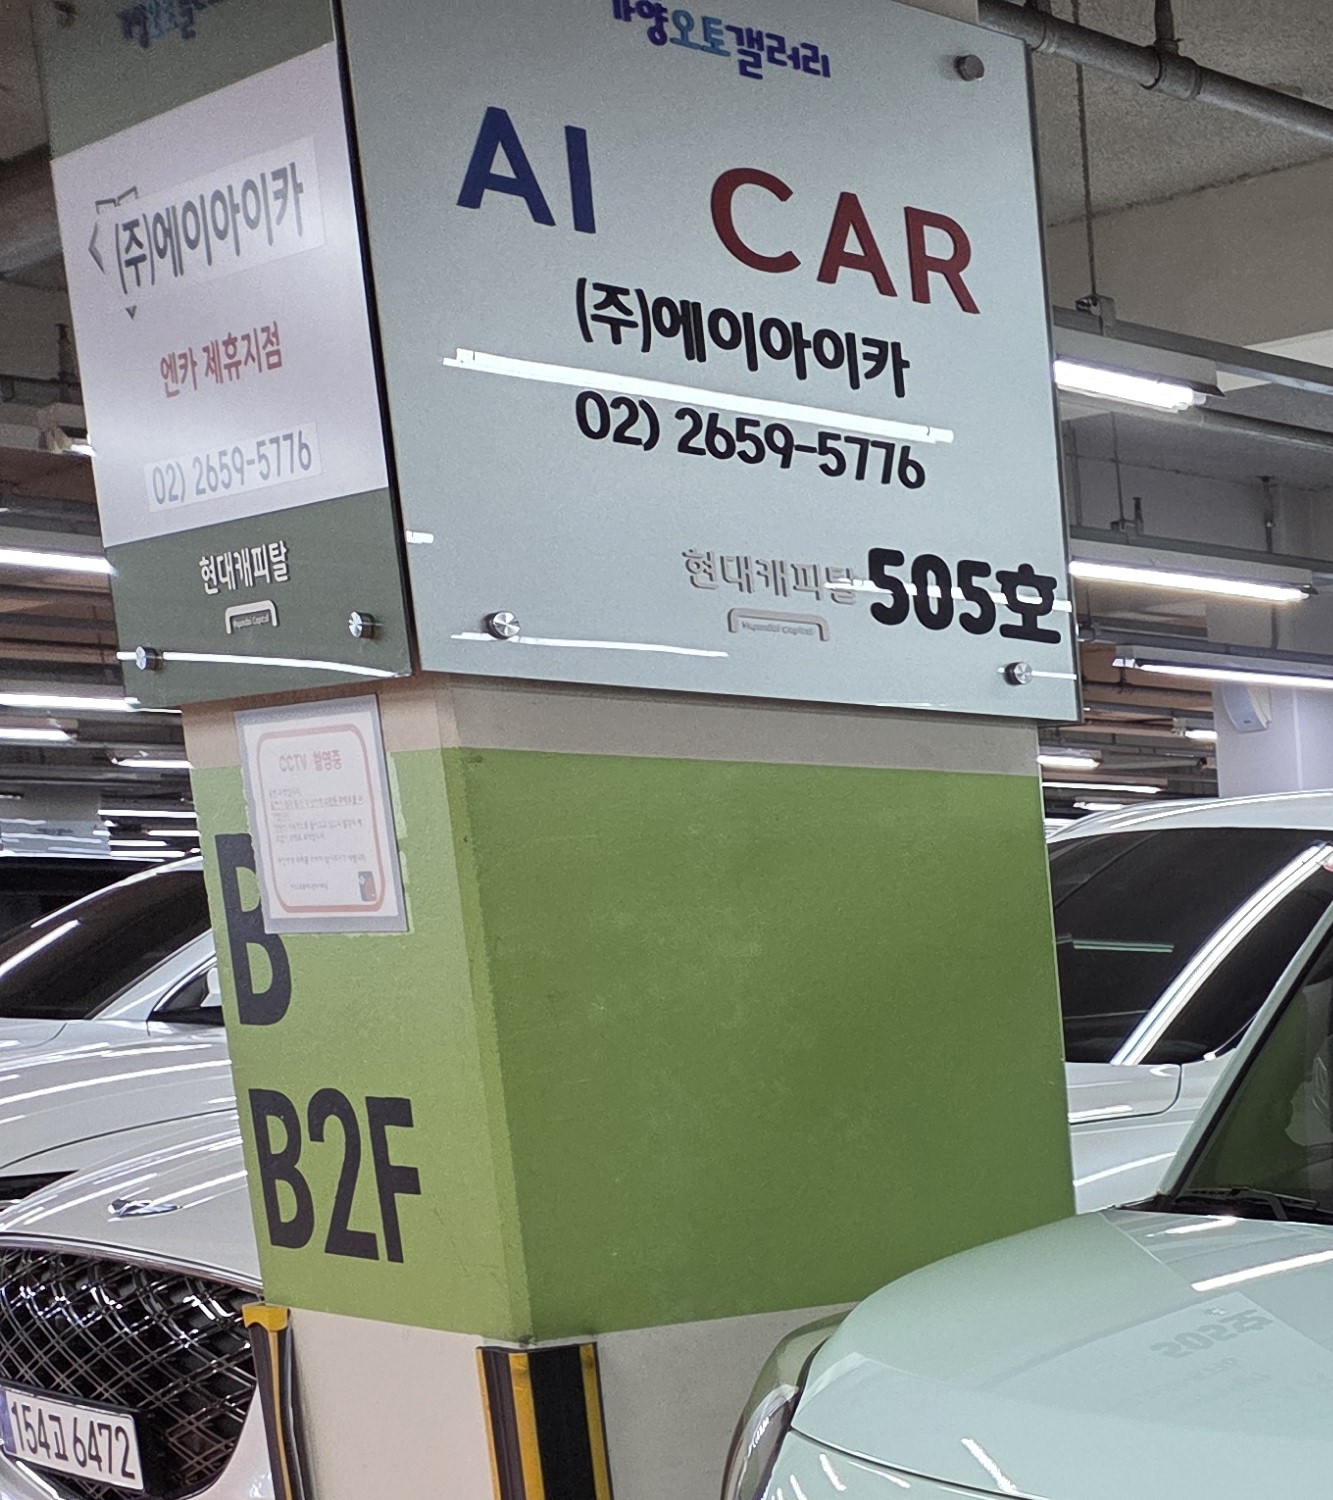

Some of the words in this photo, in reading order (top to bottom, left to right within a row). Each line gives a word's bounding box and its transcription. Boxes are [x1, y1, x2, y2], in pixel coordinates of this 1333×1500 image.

[115, 161, 304, 294] (주)에이아이카
[457, 105, 596, 234] AI
[710, 167, 981, 314] CAR
[160, 352, 198, 399] 엔카
[203, 321, 284, 386] 제휴지점
[575, 277, 911, 398] (주)에이아이카
[151, 460, 187, 506] 02)
[195, 430, 313, 497] 2659-5776
[575, 390, 660, 451] 02)
[674, 407, 926, 489] 2659-5776
[198, 540, 289, 595] 현대캐피탈
[682, 549, 857, 606] 현대캐피탈
[866, 547, 1062, 645] 505호
[279, 753, 307, 773] CCTV
[248, 1087, 422, 1264] B2F
[11, 1401, 69, 1462] 154고
[73, 1417, 136, 1480] 6472
